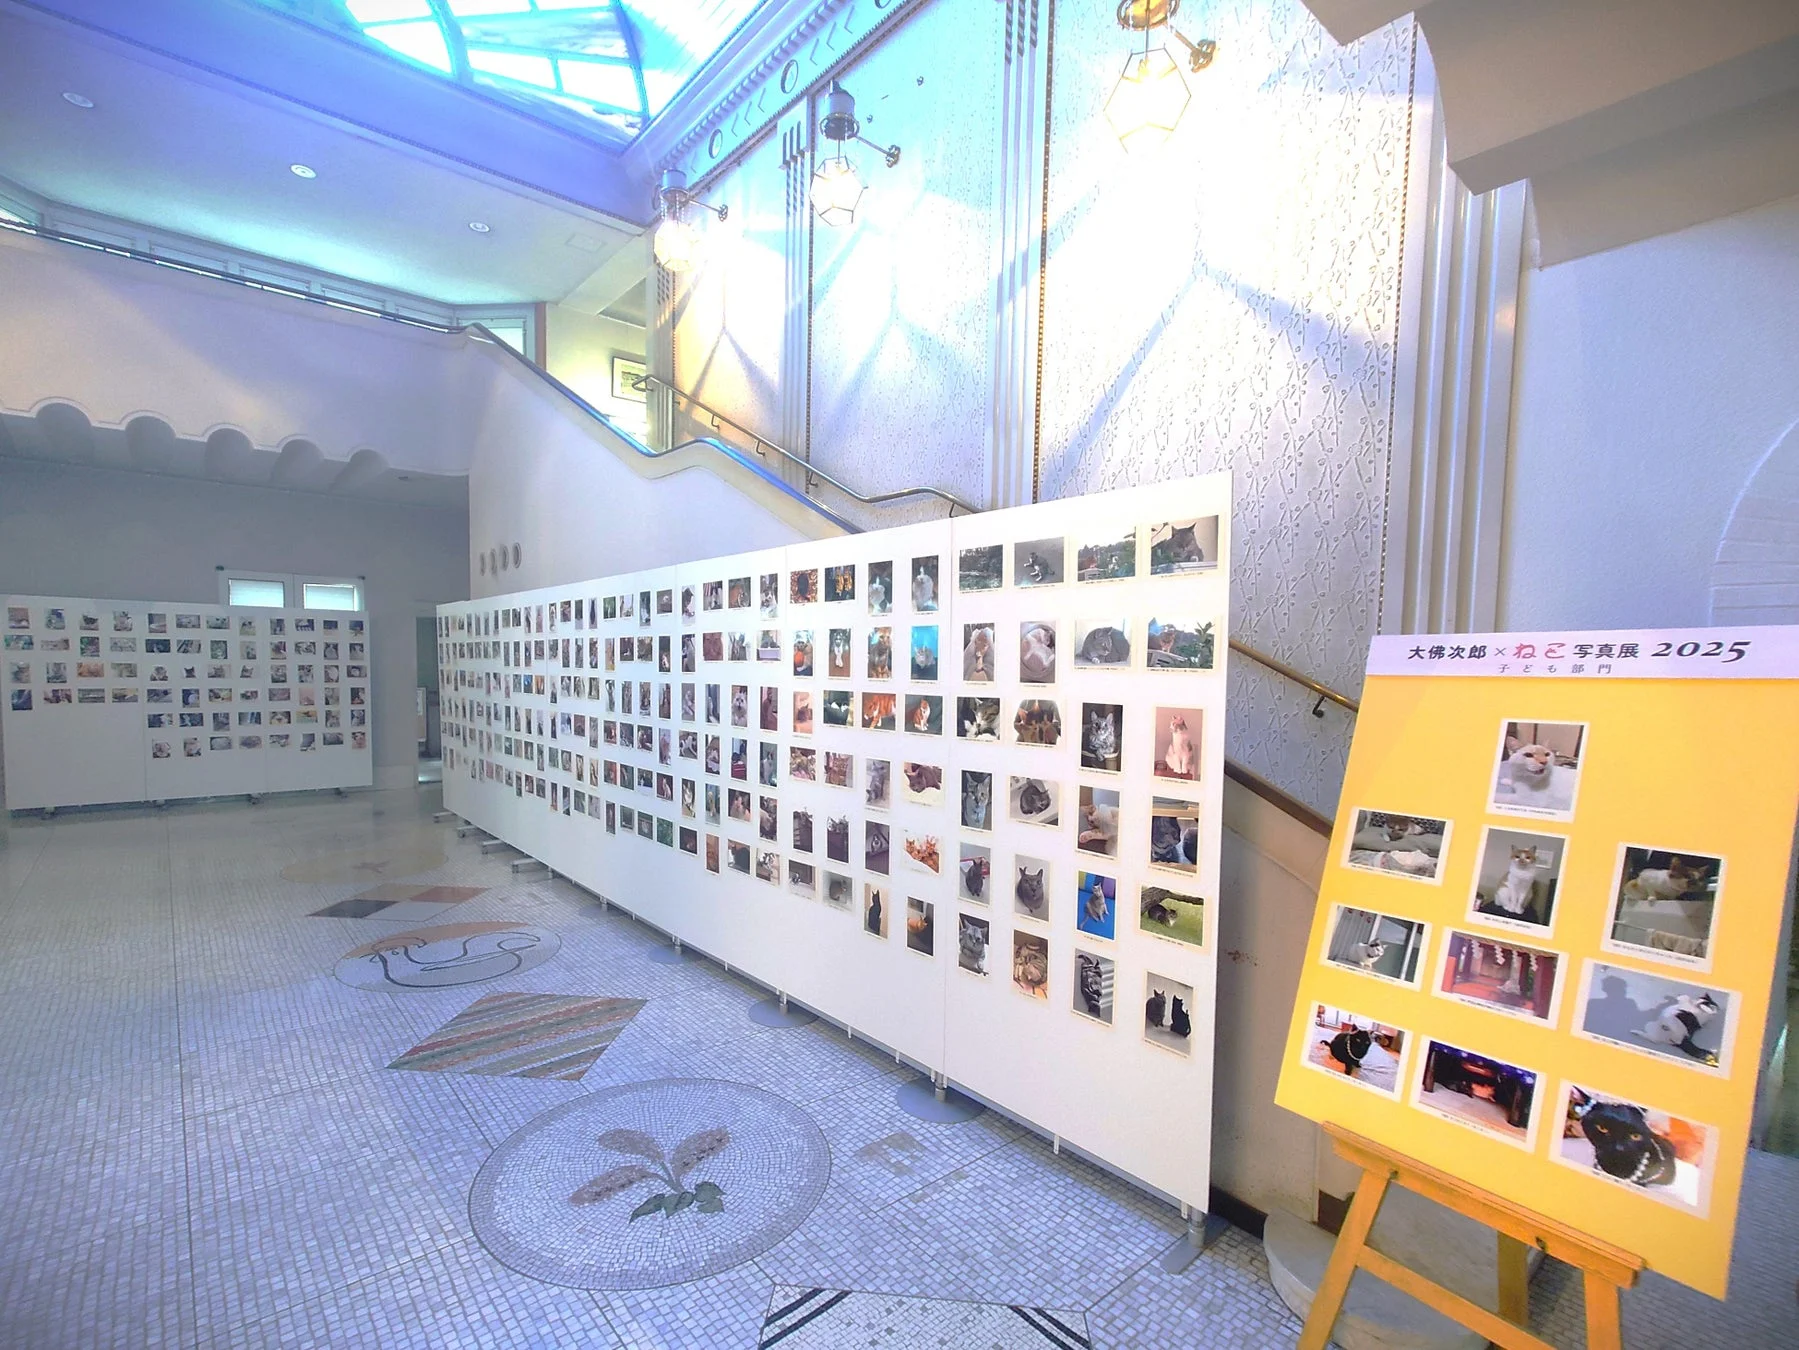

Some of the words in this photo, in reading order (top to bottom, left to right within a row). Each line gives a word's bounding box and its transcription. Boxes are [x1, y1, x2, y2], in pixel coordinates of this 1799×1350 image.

[1650, 641, 1752, 663] 2025
[1498, 663, 1612, 674] 子ども部門
